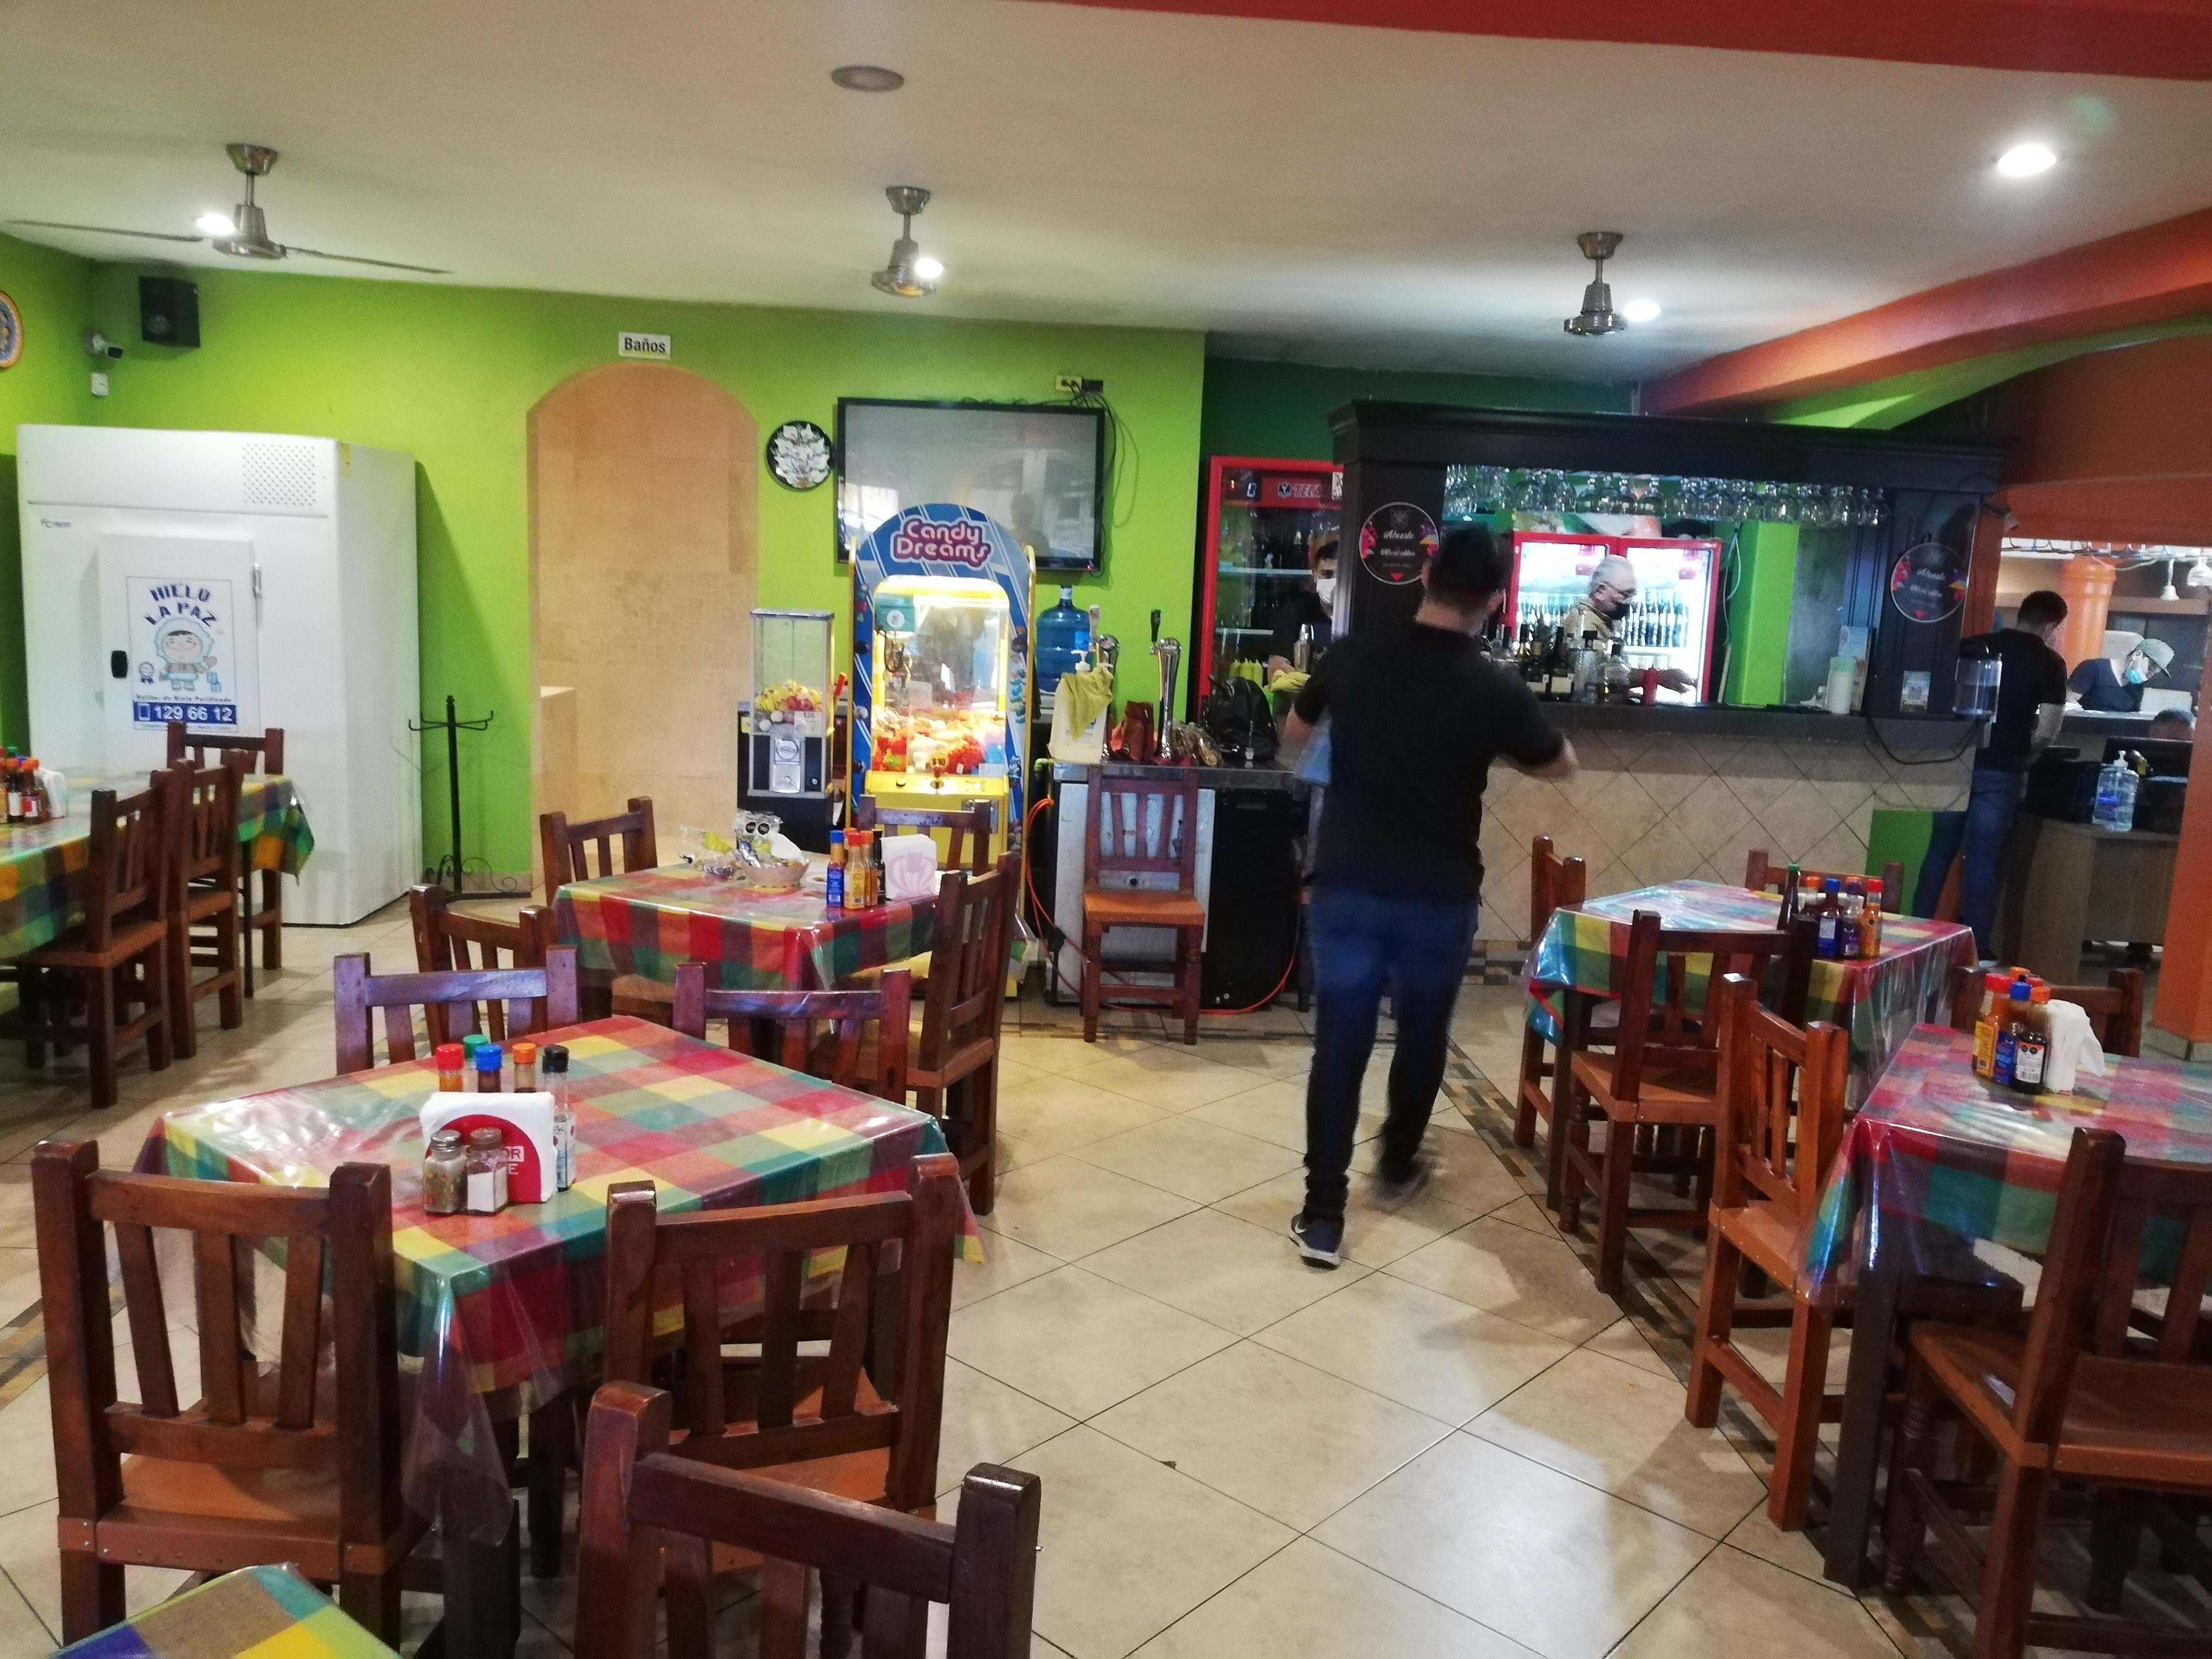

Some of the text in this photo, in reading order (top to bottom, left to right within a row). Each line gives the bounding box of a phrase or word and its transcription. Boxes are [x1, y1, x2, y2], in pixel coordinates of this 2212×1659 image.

[625, 337, 665, 353] Baños
[906, 520, 981, 545] Candy
[896, 537, 989, 563] Dreams
[149, 583, 210, 602] HIELO
[144, 601, 216, 628] LA PAZ
[154, 705, 232, 721] 129 66 12
